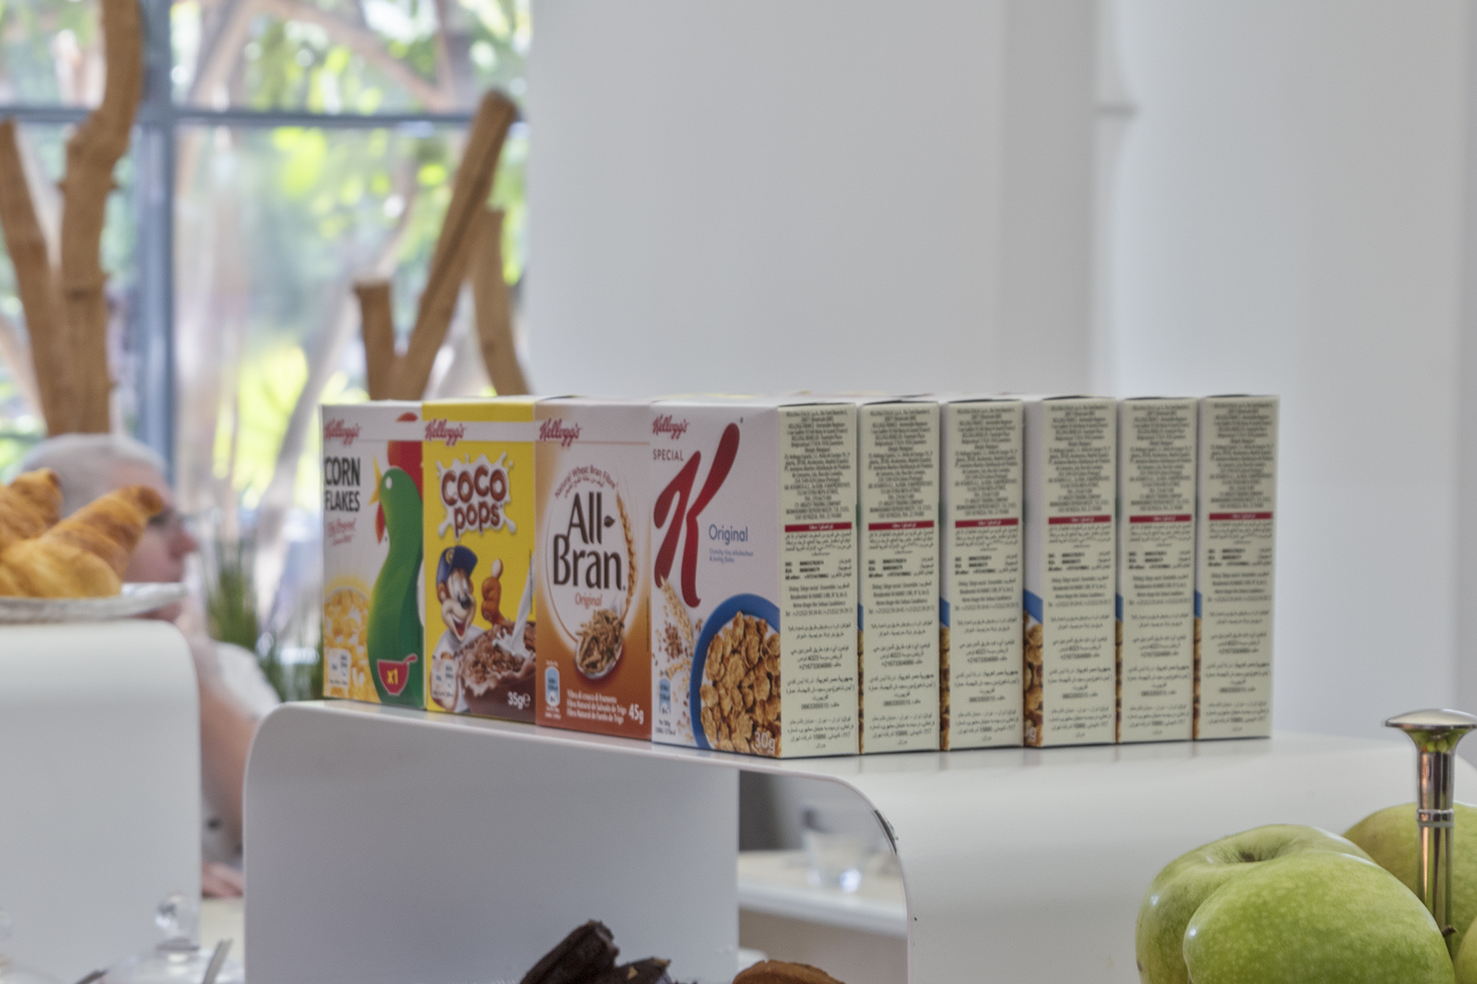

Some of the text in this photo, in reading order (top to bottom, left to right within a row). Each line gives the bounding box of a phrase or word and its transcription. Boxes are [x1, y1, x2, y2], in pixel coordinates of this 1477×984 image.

[425, 417, 466, 447] Kellogg's
[539, 418, 581, 447] Kellogg's
[653, 414, 689, 440] Kellogg's
[653, 449, 684, 461] SPECIAL
[324, 456, 361, 487] CORN
[325, 490, 361, 512] FLAKES
[454, 501, 501, 540] pops
[653, 422, 740, 608] K
[708, 523, 748, 546] Original
[553, 533, 622, 591] Bran
[574, 592, 603, 609] Original
[386, 668, 399, 685] x1
[628, 703, 645, 725] 45g
[754, 730, 775, 754] 30g
